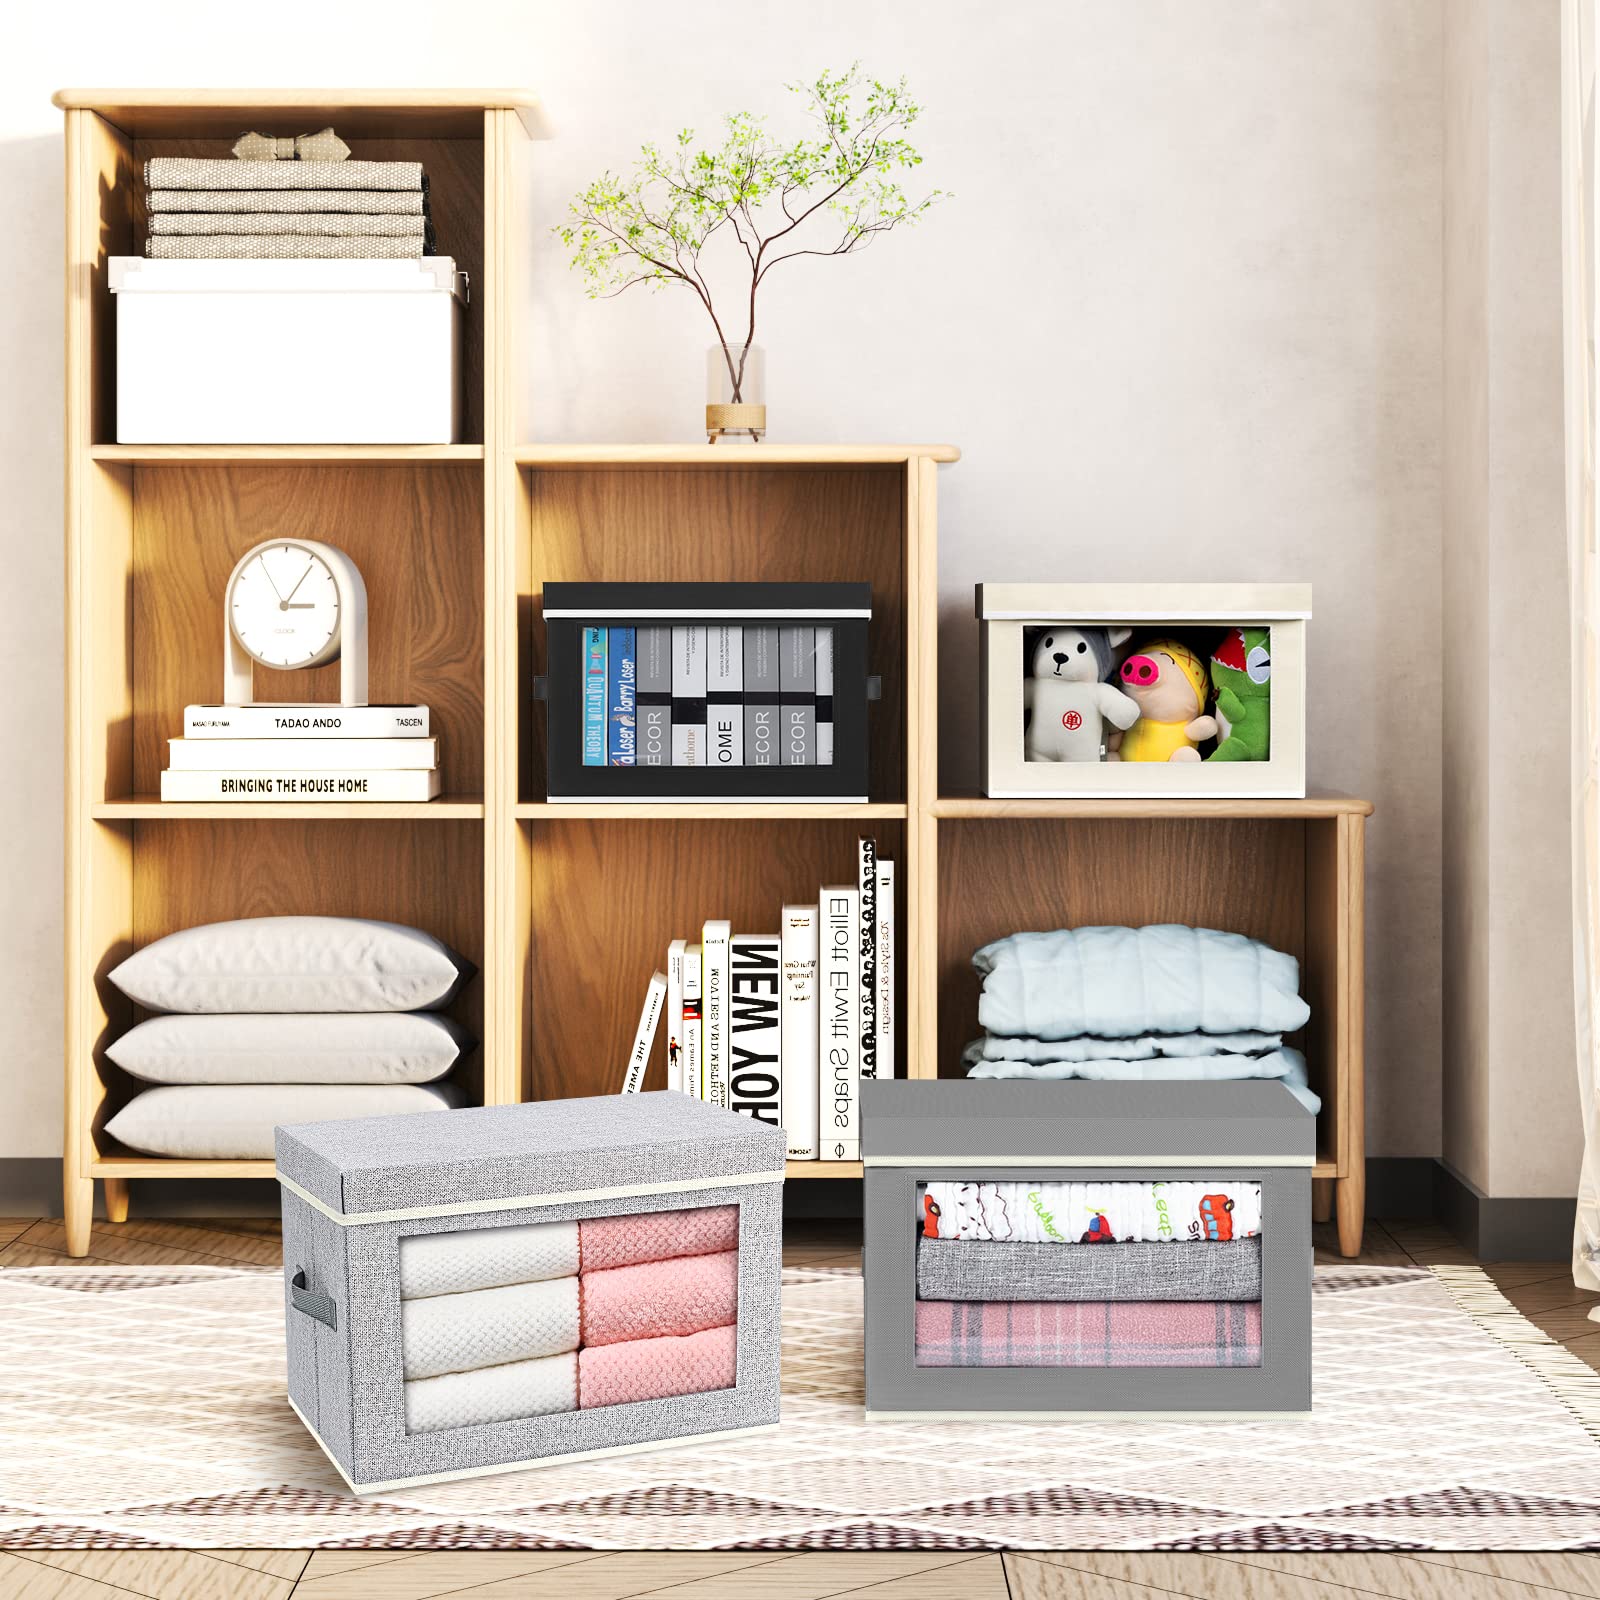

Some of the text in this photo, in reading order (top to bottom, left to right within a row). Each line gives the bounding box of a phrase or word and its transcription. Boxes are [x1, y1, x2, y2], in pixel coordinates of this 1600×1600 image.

[618, 658, 635, 683] Loser
[613, 683, 635, 712] Barry
[275, 718, 342, 729] TADAO ANDO
[396, 718, 423, 727] TASCEN
[586, 676, 604, 758] QUANTUM THEORY
[612, 727, 635, 755] Loser
[682, 729, 695, 766] athome
[718, 721, 733, 763] OME
[221, 779, 368, 793] BRINGING THE HOUSE HOME
